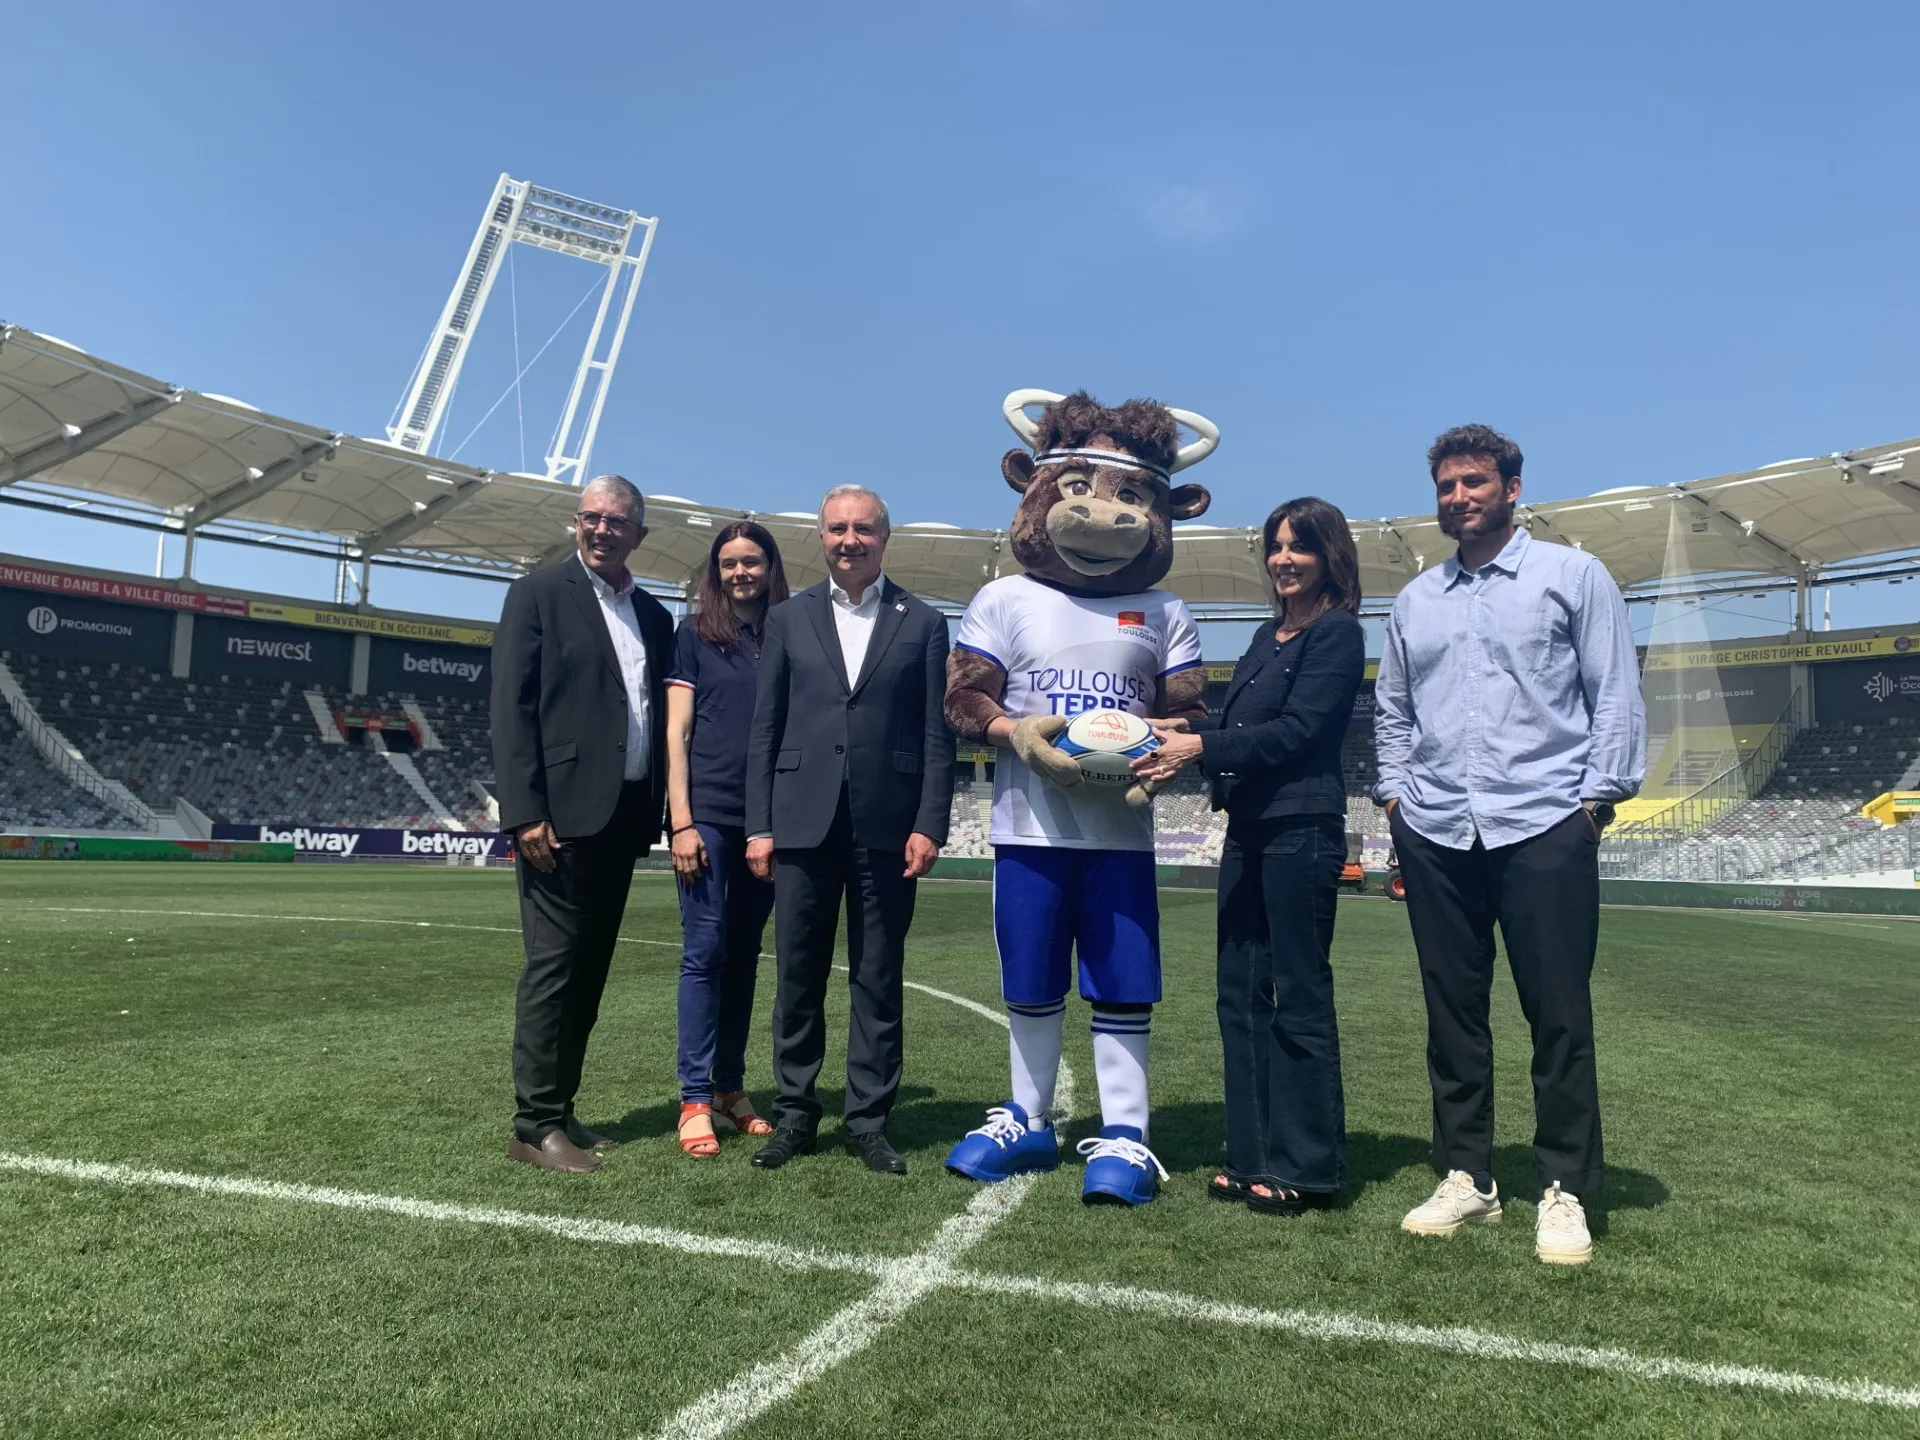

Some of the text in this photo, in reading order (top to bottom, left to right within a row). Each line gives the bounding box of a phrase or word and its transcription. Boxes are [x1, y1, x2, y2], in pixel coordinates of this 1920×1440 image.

[63, 577, 100, 594] DANS
[103, 584, 121, 597] LA
[124, 586, 161, 602] VILLE
[60, 618, 133, 636] PROMOTION
[315, 612, 377, 631] BIENVENUE
[380, 621, 395, 633] EN
[1117, 628, 1157, 644] TOULOUSE
[1688, 652, 1732, 665] VIRAGE
[1734, 643, 1812, 662] CHRISTOPHE
[1816, 641, 1873, 656] REVAULT
[403, 653, 483, 682] betway
[1027, 667, 1146, 704] TOULOUSE
[1088, 730, 1129, 742] TOULOUSE
[1081, 769, 1137, 782] ILBERT
[260, 826, 359, 857] betway
[402, 830, 494, 855] betway
